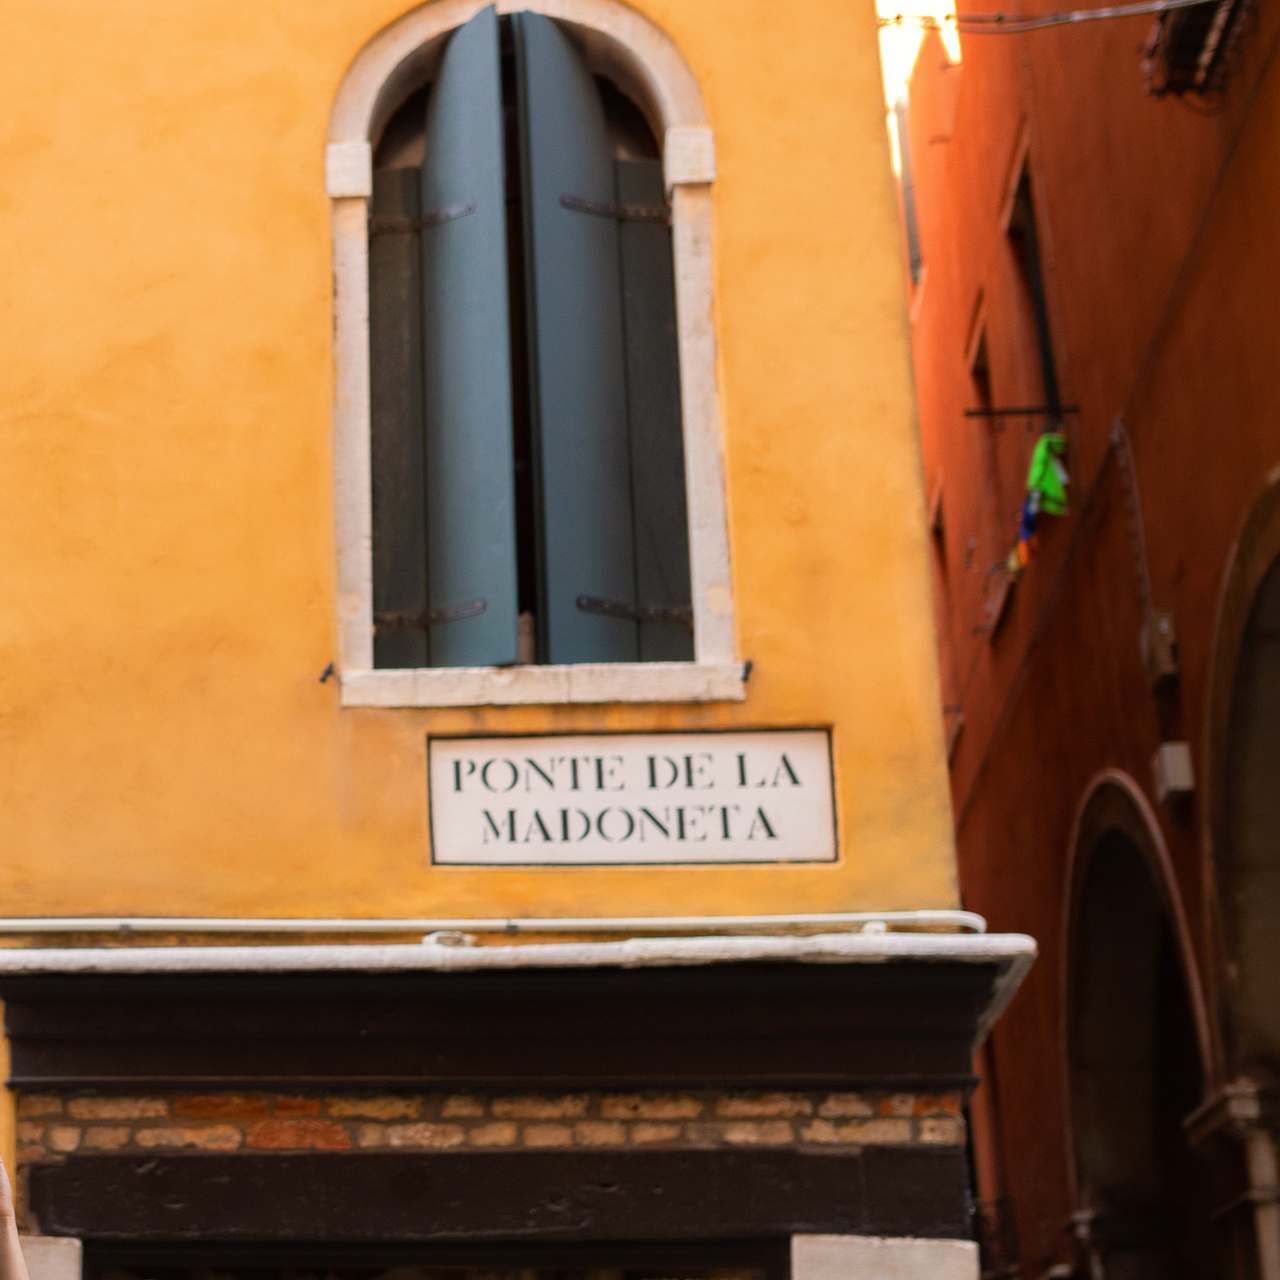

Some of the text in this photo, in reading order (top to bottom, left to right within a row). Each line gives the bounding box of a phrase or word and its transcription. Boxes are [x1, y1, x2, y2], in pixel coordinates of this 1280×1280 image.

[452, 752, 803, 793] PONTE DE LA
[482, 805, 779, 845] MADONETA
